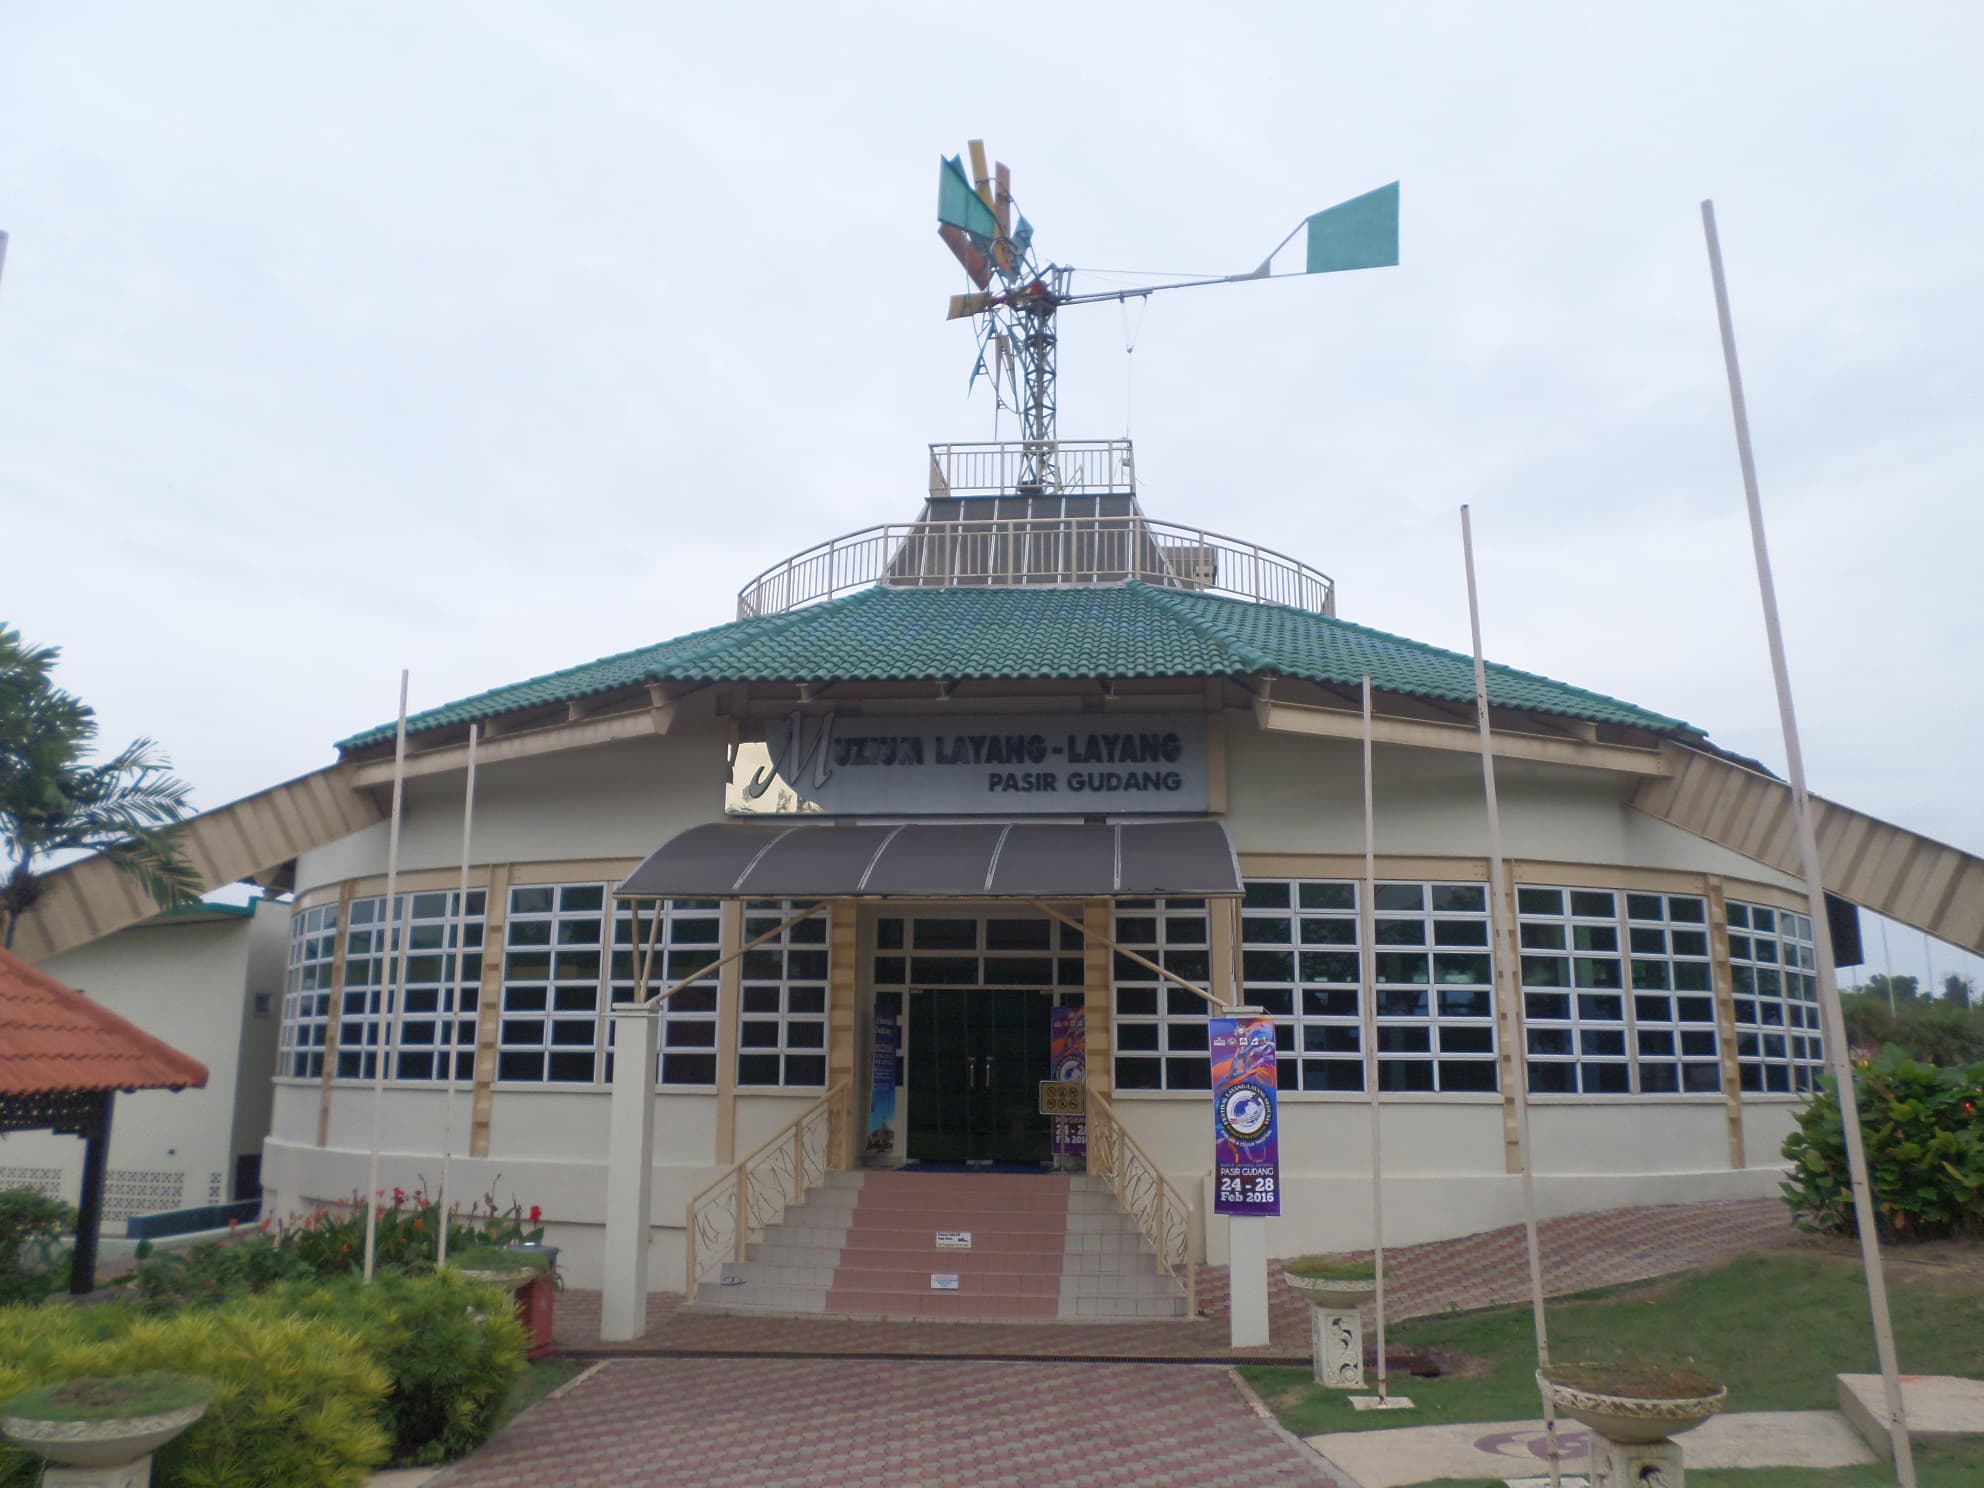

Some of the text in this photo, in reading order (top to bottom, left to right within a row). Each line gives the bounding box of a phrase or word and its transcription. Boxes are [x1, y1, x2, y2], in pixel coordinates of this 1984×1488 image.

[988, 771, 1182, 792] PASIR GUDANG
[1056, 1136, 1070, 1144] Fb
[1220, 1167, 1274, 1176] PASIR GUDANG
[1220, 1177, 1242, 1192] 24
[1255, 1177, 1274, 1192] 28
[1220, 1192, 1274, 1203] Feb 2016
